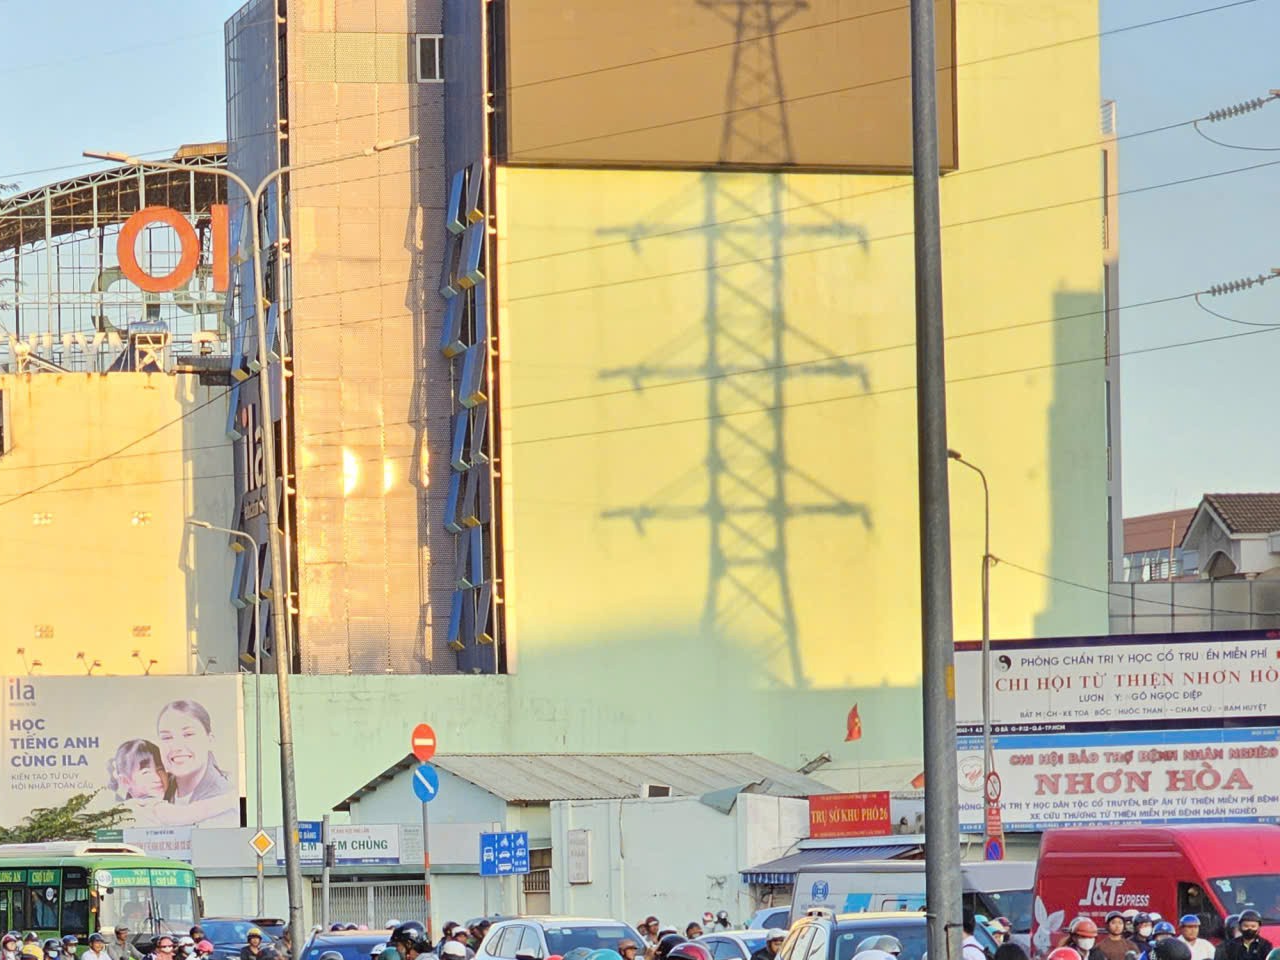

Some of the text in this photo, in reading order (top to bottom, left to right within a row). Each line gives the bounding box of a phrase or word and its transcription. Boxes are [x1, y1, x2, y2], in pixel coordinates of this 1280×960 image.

[9, 678, 35, 700] ila
[995, 677, 1029, 692] CHI
[1037, 675, 1071, 693] HỘI
[9, 719, 46, 734] HỌC
[9, 733, 100, 749] TIẾNG ANH
[10, 751, 89, 767] CÙNG ILA
[1034, 761, 1253, 796] NHƠN HÒA
[841, 808, 860, 823] KHU
[879, 807, 888, 820] 26
[1078, 877, 1150, 907] J&T EXPRESS
